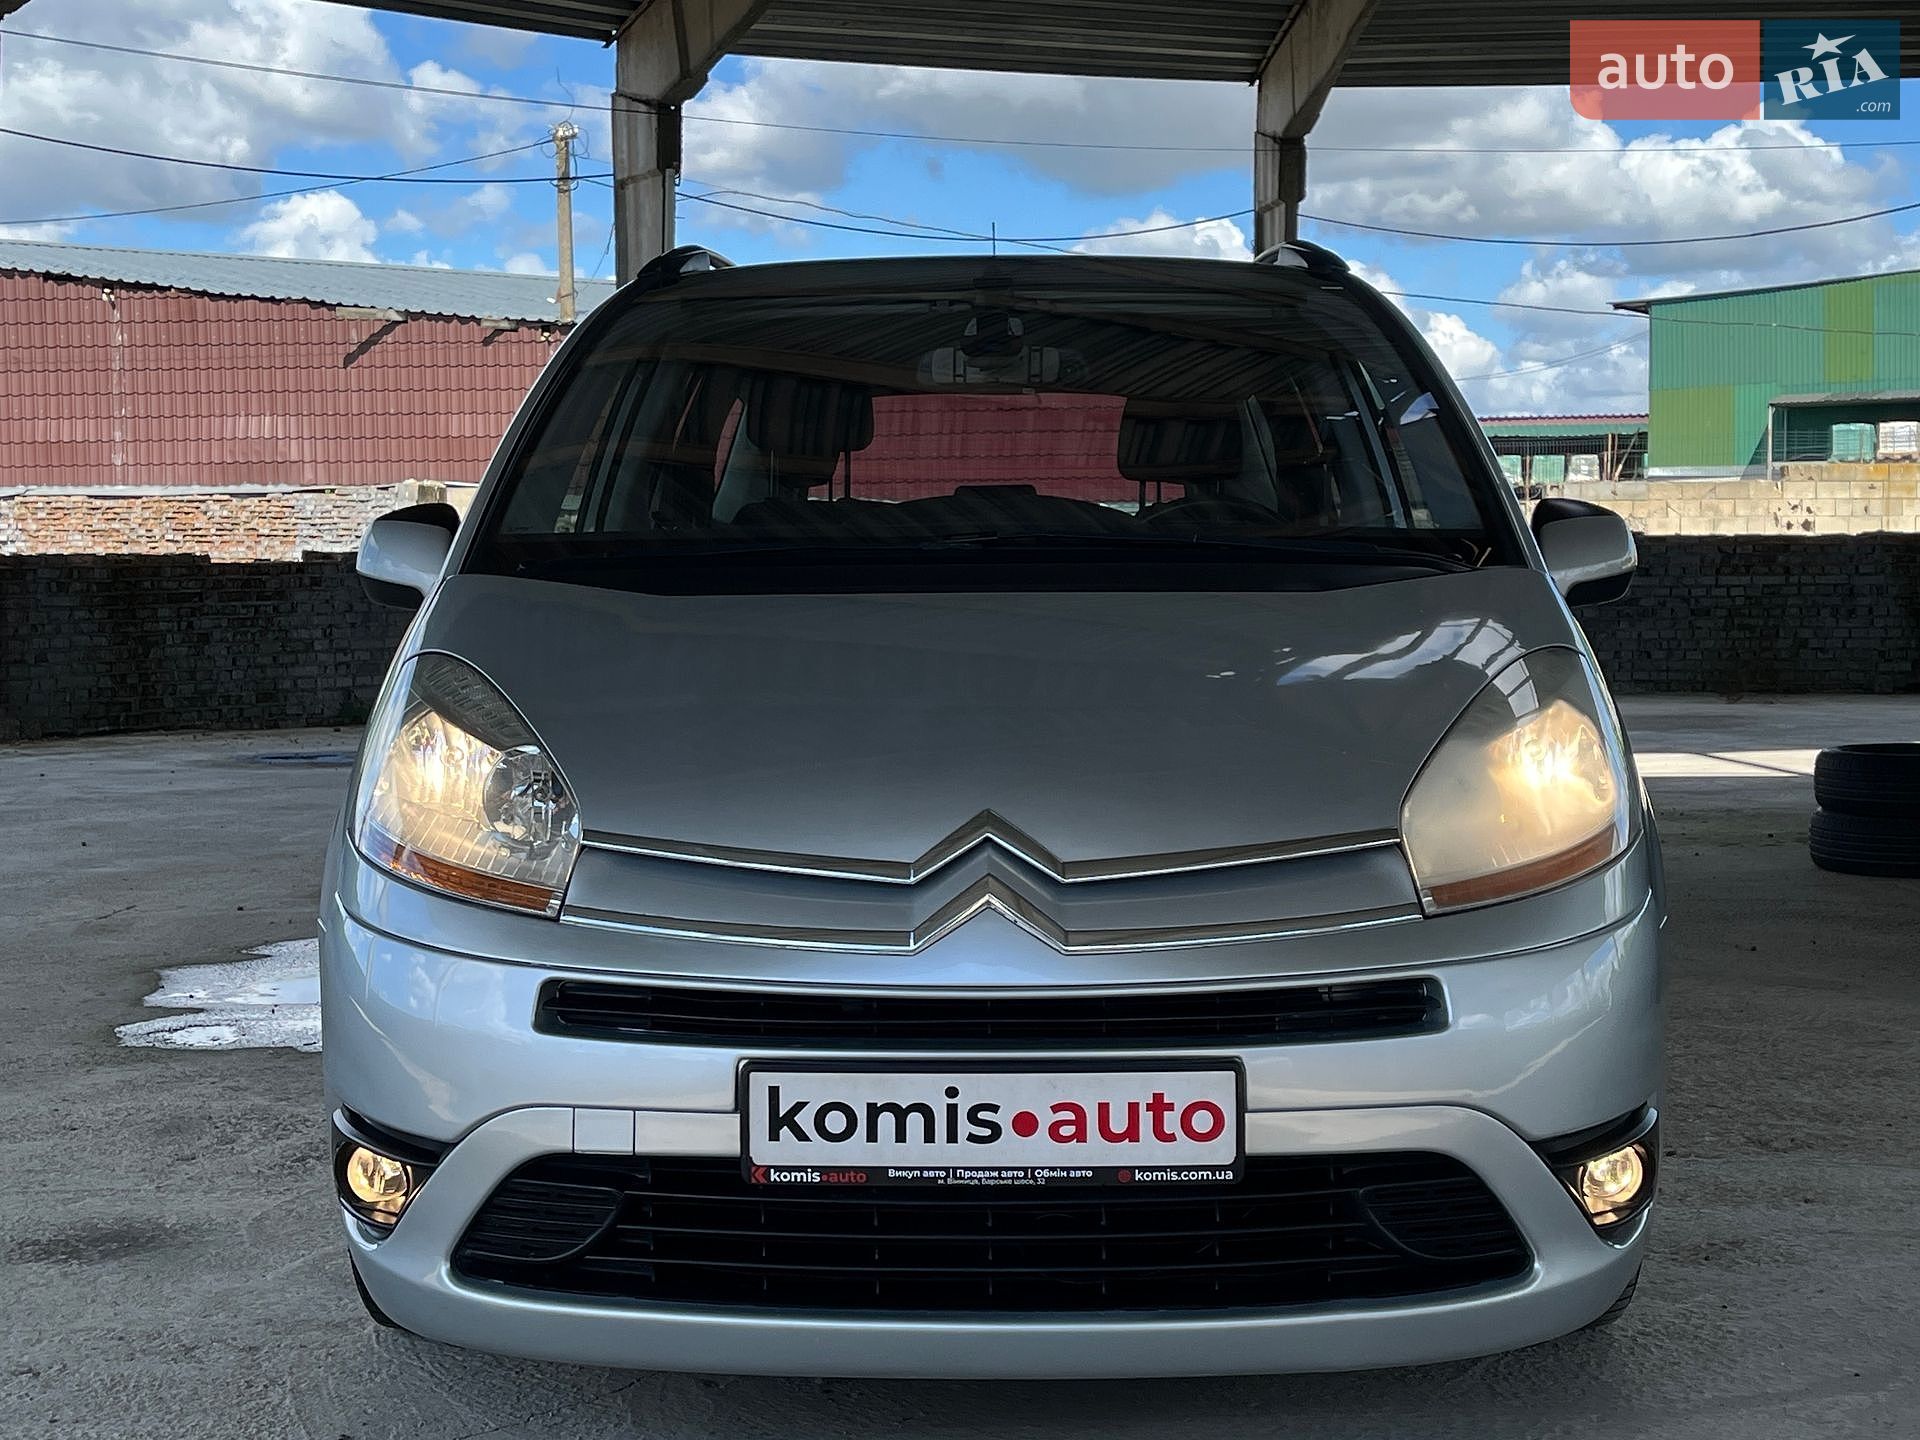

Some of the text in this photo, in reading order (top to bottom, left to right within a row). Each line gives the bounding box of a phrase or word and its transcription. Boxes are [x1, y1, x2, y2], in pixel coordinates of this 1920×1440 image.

[888, 1169, 921, 1179] Викуп
[922, 1170, 947, 1178] авто
[956, 1169, 999, 1179] Продаж
[1000, 1170, 1025, 1178] авто
[1069, 1170, 1093, 1178] авто
[1134, 1168, 1234, 1181] komis.com.ua
